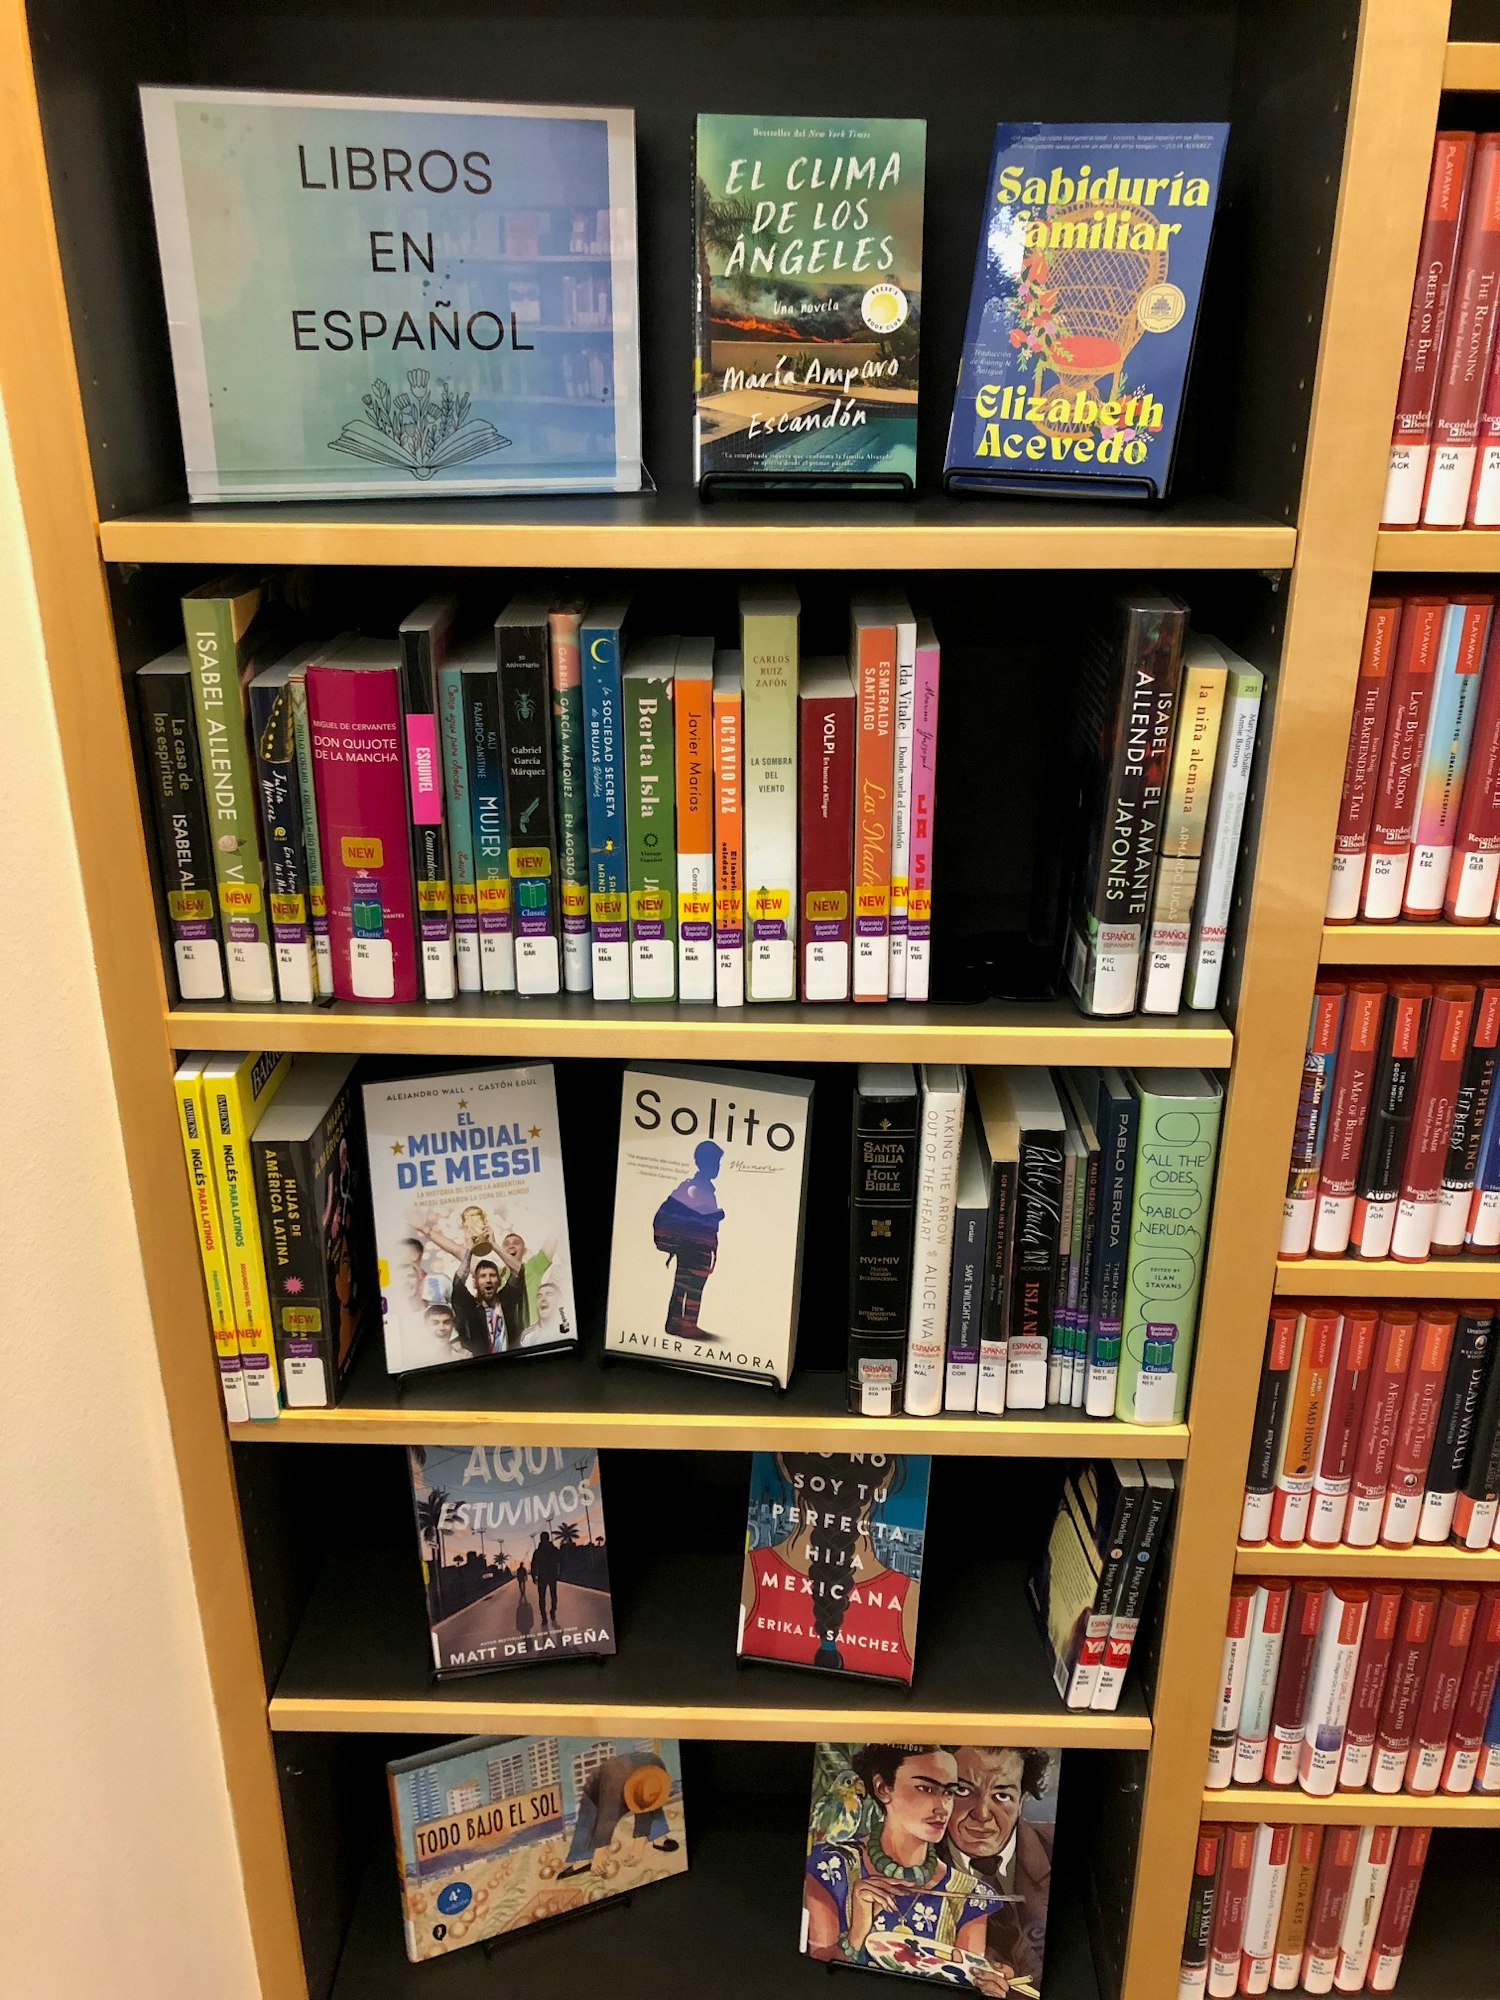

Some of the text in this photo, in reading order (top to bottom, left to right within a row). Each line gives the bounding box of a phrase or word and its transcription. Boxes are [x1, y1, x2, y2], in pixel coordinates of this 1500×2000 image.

[299, 145, 492, 195] LIBROS
[725, 151, 901, 194] EL CLIMA
[996, 165, 1209, 206] Sabiduría
[1440, 146, 1456, 210] PLAYAWAY
[752, 198, 869, 235] DE LOS
[1013, 209, 1183, 251] familiar
[369, 231, 435, 272] EN
[724, 235, 894, 278] ÁNGELES
[1424, 261, 1443, 309] GREEN
[292, 300, 534, 352] ESPAÑOL
[773, 300, 839, 315] Una novela
[1414, 338, 1432, 373] BLUE
[1464, 306, 1489, 382] RECKONING
[723, 355, 899, 394] María Amparo
[748, 398, 866, 440] Escandón
[975, 384, 1164, 428] Elizabeth
[976, 423, 1148, 465] Acevedo
[753, 655, 790, 664] CARLOS
[1371, 615, 1386, 671] PLAYAWAY
[755, 677, 788, 688] ZAFÓN
[760, 667, 783, 676] RUIZ
[863, 668, 876, 731] SANTIAGO
[878, 661, 891, 737] ESMERALDA
[898, 664, 913, 730] Ida Vitale
[1364, 688, 1380, 713] THE
[196, 632, 237, 820] ISABEL ALLENDE
[314, 735, 398, 750] DON QUIJOTE
[473, 702, 487, 778] FAJARDO-ANSTINE
[487, 731, 497, 750] KALI
[559, 647, 574, 798] GABRIEL GARCÍA MÁRQUEZ
[591, 722, 601, 763] BRUJAS
[823, 713, 836, 754] VOLPI
[1124, 670, 1155, 777] ALLENDE
[1151, 692, 1174, 757] ISABEL
[154, 713, 174, 797] los espíritus
[172, 719, 193, 790] La casa de
[315, 750, 398, 762] DE LA MANCHA
[416, 747, 433, 793] ESQUIVEL
[511, 747, 542, 755] Gabriel
[514, 757, 540, 765] García
[602, 699, 615, 818] SOCIEDAD SECRETA
[639, 699, 660, 818] Berta Isla
[688, 712, 703, 812] Javier Marías
[720, 715, 737, 814] OCTAVIO PAZ
[751, 757, 793, 766] LA SOMBRA
[1183, 685, 1214, 813] la niña alemana
[510, 768, 546, 777] Márquez
[759, 784, 785, 793] VIENTO
[765, 771, 778, 780] DEL
[862, 778, 887, 816] Las
[1350, 795, 1364, 821] TALE
[172, 814, 192, 867] ISABEL
[478, 796, 501, 857] MUJER
[349, 847, 375, 858] NEW
[1106, 798, 1135, 900] JAPONÉS
[1129, 786, 1161, 914] EL AMANTE
[1102, 931, 1136, 940] ESPAÑOL
[1153, 930, 1189, 939] ESPAÑOL
[386, 1087, 465, 1102] ALEJANDRO WALL
[478, 1078, 538, 1092] GASTÓN EDUL
[457, 1112, 475, 1126] EL
[634, 1089, 796, 1152] Solito
[1464, 1059, 1496, 1173] STEPHEN KING
[407, 1123, 527, 1158] MUNDIAL
[863, 1142, 906, 1154] SANTA
[863, 1152, 904, 1164] BIBLIA
[1146, 1154, 1205, 1168] ALL THE
[397, 1147, 541, 1190] DE MESSI
[865, 1180, 901, 1192] BIBLE
[866, 1169, 900, 1182] HOLY
[920, 1111, 938, 1242] OUT OF THE HEART
[936, 1108, 956, 1245] TAKING THE ARROW
[1110, 1113, 1129, 1248] PABLO NERUDA
[1156, 1170, 1194, 1184] ODES
[191, 1148, 215, 1252] INGLÉS PARA LATINOS
[223, 1144, 245, 1248] INGLÉS PARA LATINOS
[264, 1149, 289, 1266] AMÉRICA LATINA
[284, 1179, 301, 1237] HIJAS DE
[1146, 1206, 1192, 1220] PABLO
[1140, 1222, 1196, 1236] NERUDA
[923, 1265, 938, 1310] ALICE
[619, 1330, 776, 1371] JAVIER ZAMORA
[1301, 1401, 1319, 1463] MAD HONEY
[437, 1478, 595, 1531] ESTUVIMOS
[793, 1473, 888, 1504] SOY TU
[772, 1503, 904, 1543] PERFECTA
[804, 1544, 864, 1571] HIJA
[761, 1571, 902, 1611] MEXICANA
[450, 1647, 497, 1666] MATT
[504, 1642, 528, 1657] DE
[534, 1637, 555, 1652] LA
[562, 1629, 610, 1647] PEÑA
[758, 1617, 900, 1653] ERIKA L. SÁNCHEZ
[417, 1792, 560, 1856] TODO BAJO EL SOL
